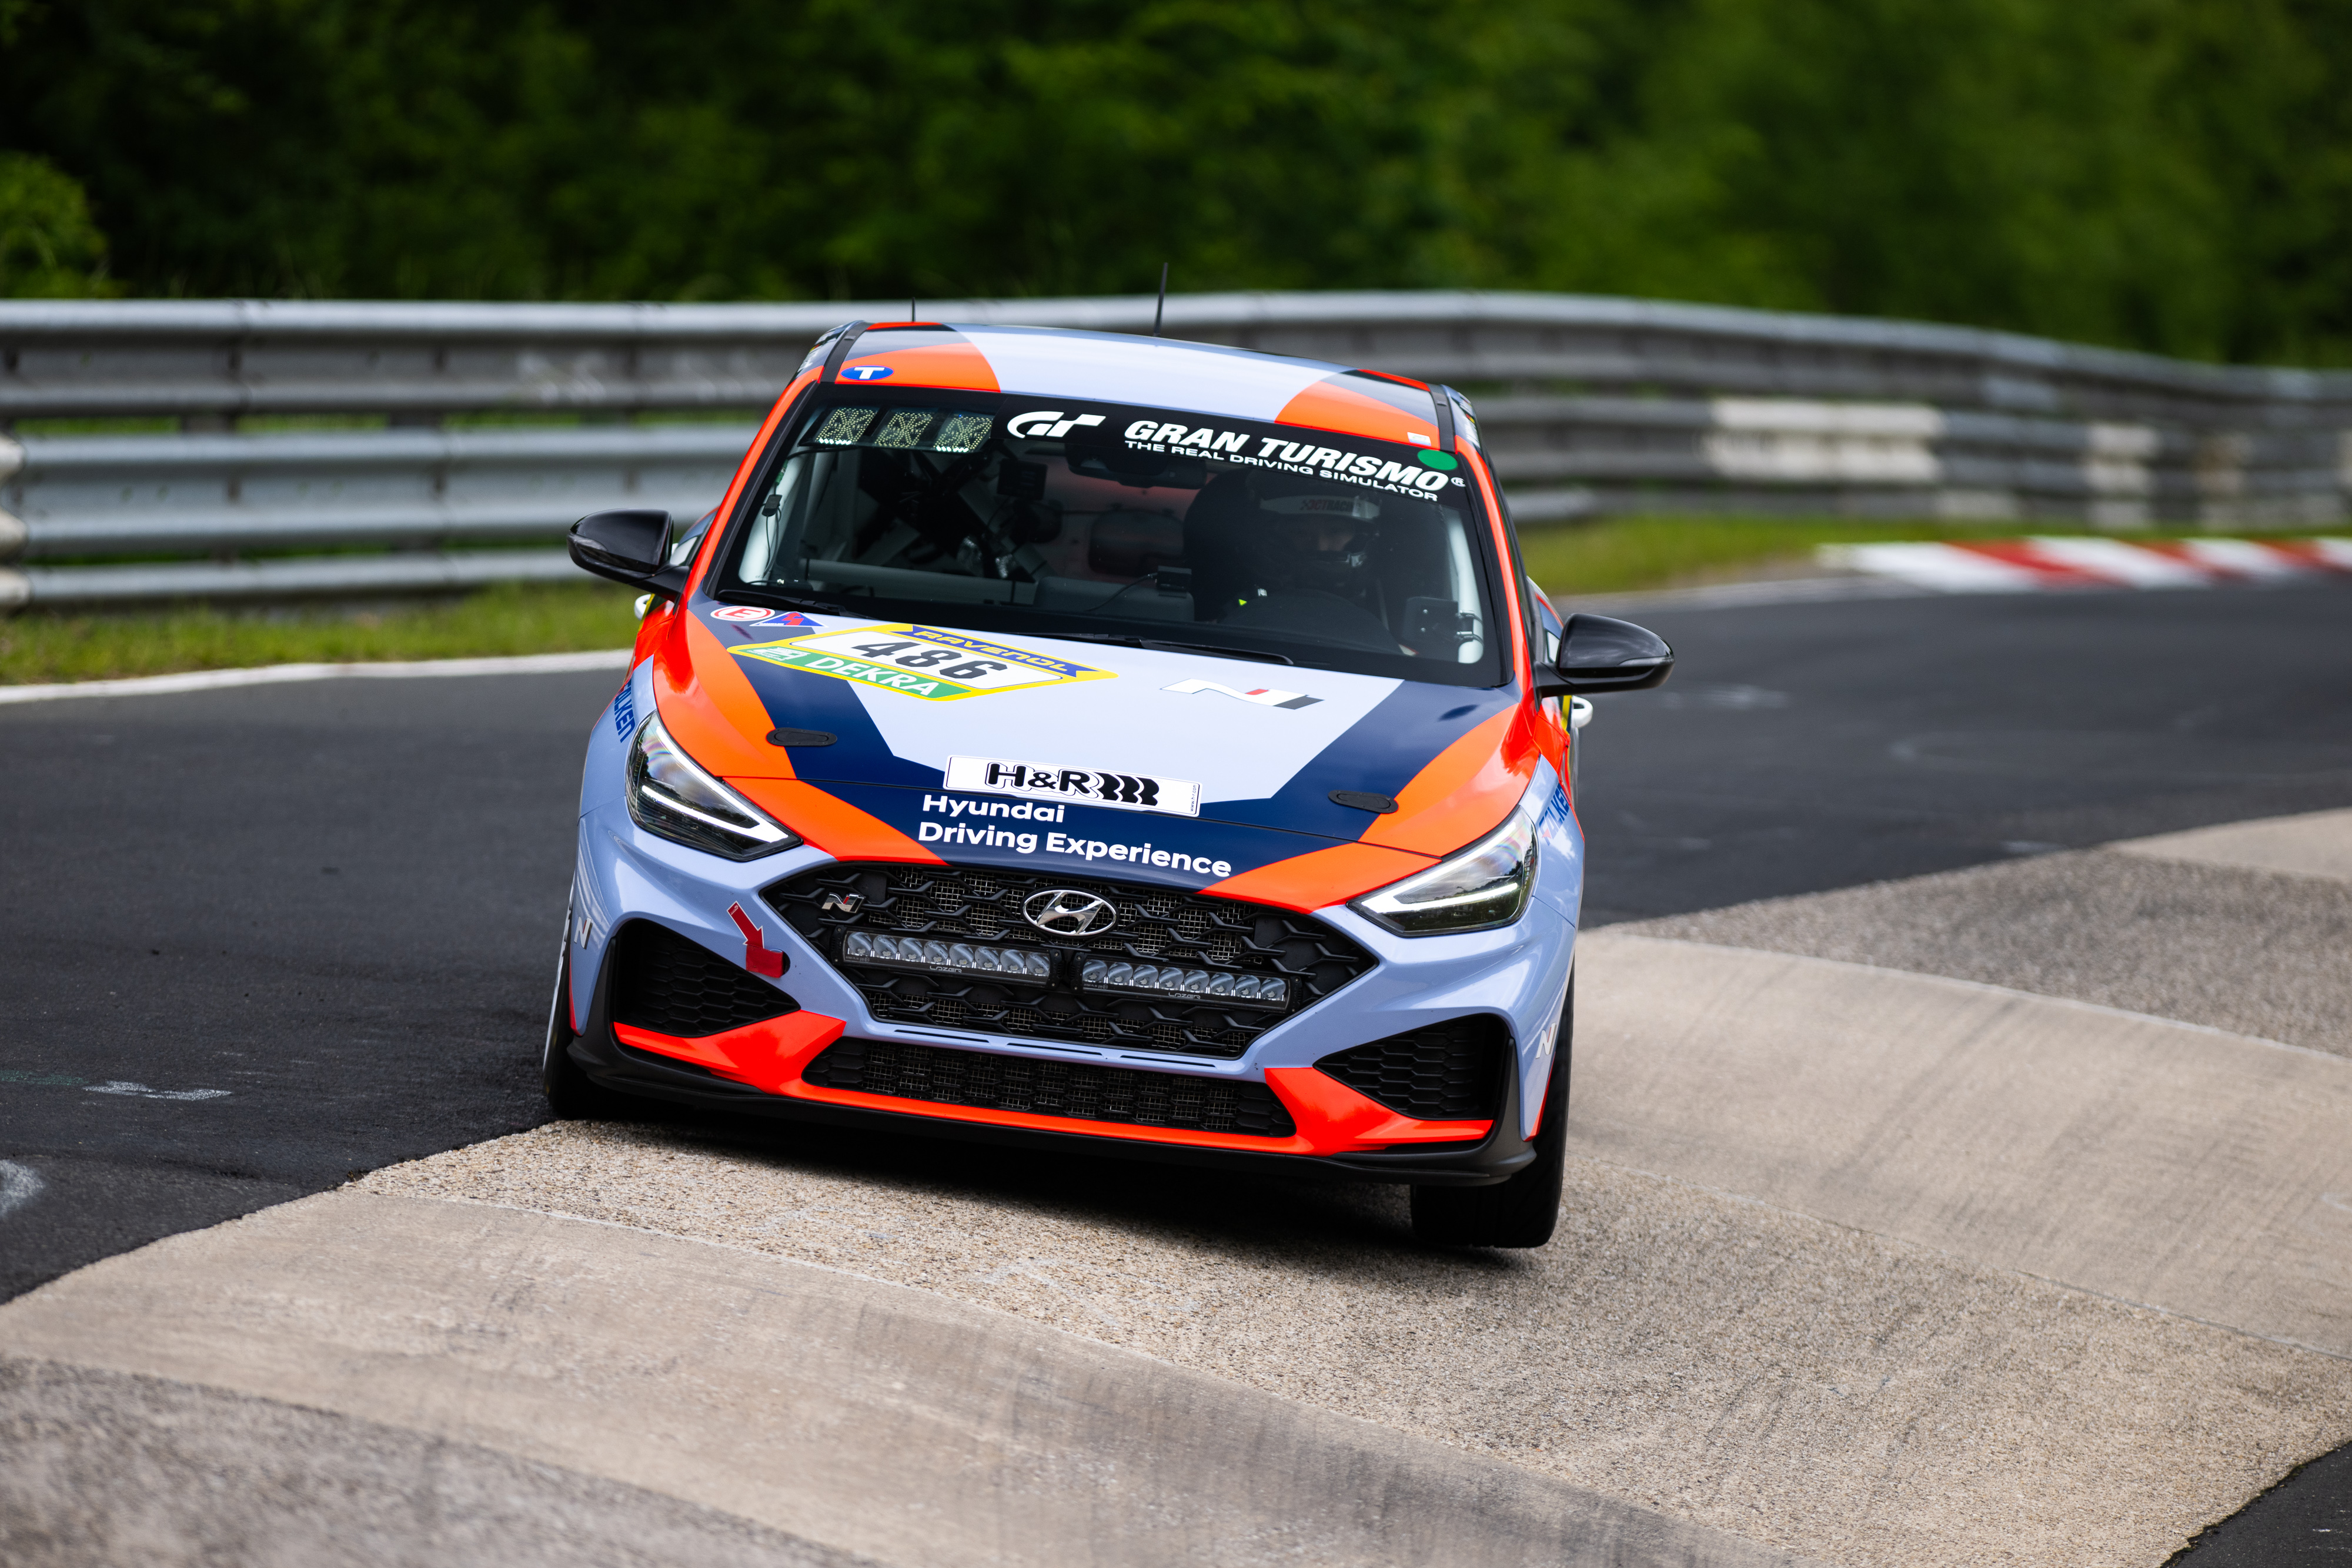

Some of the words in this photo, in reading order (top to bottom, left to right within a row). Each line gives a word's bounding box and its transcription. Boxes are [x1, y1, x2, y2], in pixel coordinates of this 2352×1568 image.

[854, 366, 885, 379] T
[1124, 420, 1250, 453] GRAN
[1124, 440, 1165, 452] THE
[1171, 446, 1224, 460] REAL
[1230, 454, 1314, 475] DRIVING
[1319, 470, 1438, 502] SIMULATOR
[724, 608, 761, 618] E
[850, 641, 1008, 679] 486
[913, 631, 1068, 671] RAVENOL
[804, 657, 940, 697] DEKRA
[986, 762, 1093, 795] H&R
[923, 794, 1065, 823] Hyundai
[918, 821, 1038, 854] Driving
[1045, 832, 1232, 878] Experience
[929, 965, 963, 974] LAZER
[1168, 991, 1201, 1000] LAZER
